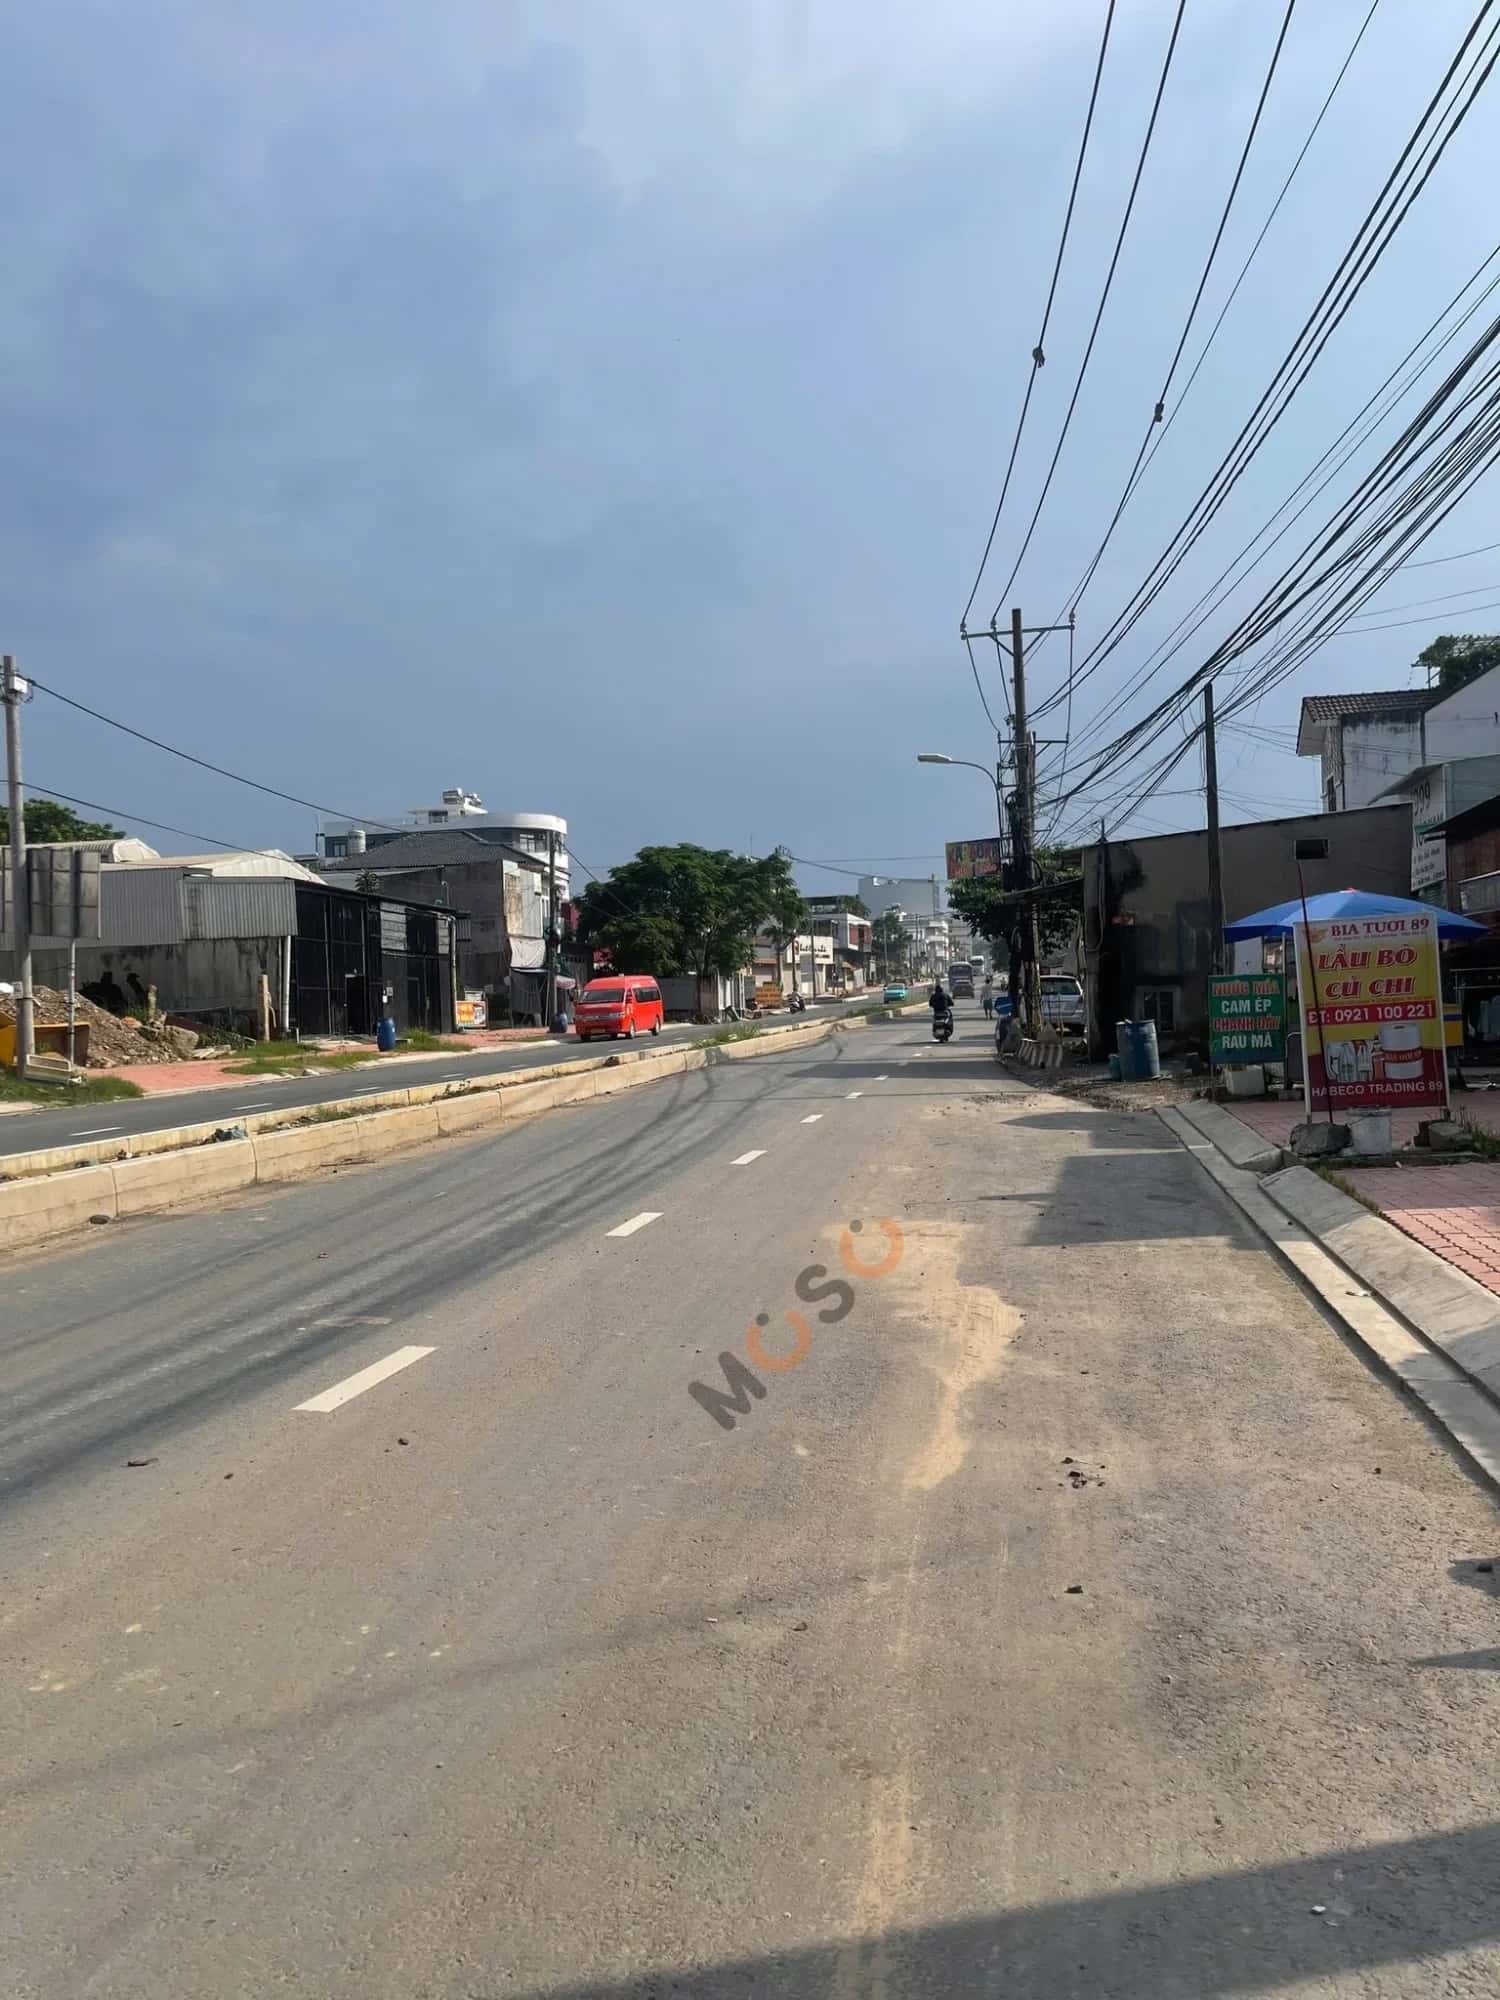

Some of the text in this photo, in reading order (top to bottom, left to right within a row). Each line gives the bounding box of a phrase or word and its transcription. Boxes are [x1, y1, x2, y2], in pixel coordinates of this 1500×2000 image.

[1331, 923, 1359, 936] BIA
[1411, 918, 1429, 930] 89
[1369, 976, 1415, 998] CHI
[1221, 999, 1250, 1014] CAM
[1335, 1007, 1369, 1021] 0921
[1377, 1006, 1402, 1019] 100
[1407, 1003, 1433, 1018] 221
[1222, 1035, 1246, 1049] RAU
[1312, 1080, 1443, 1097] HABECO TRADING 89
